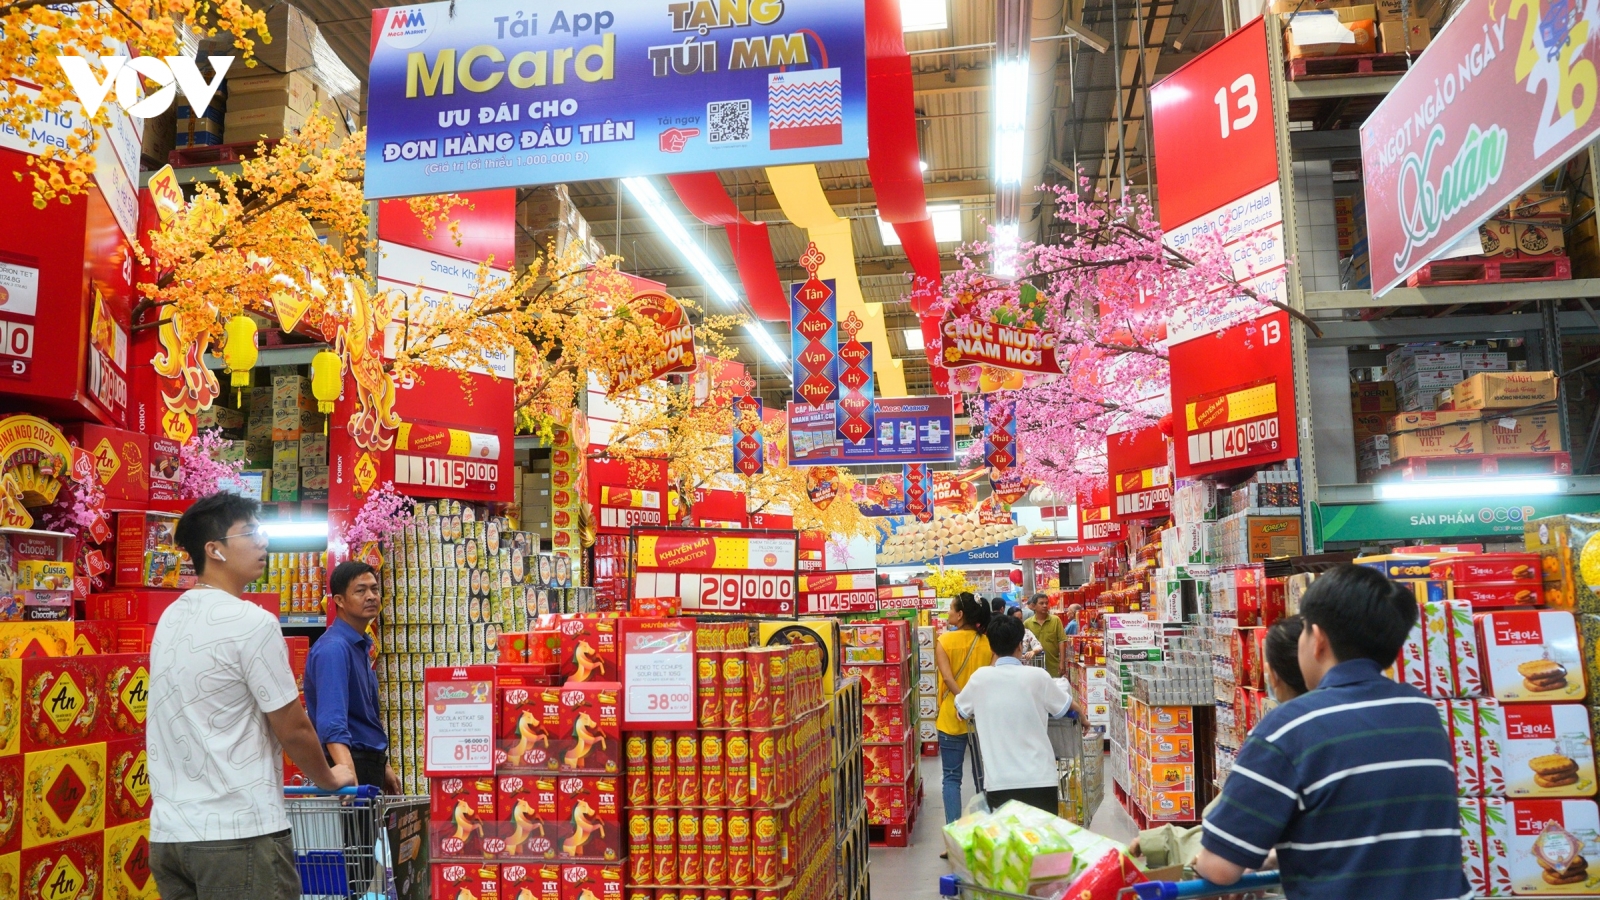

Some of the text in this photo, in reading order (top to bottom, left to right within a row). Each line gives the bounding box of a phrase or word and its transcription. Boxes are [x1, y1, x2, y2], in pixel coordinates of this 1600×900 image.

[494, 10, 614, 39] Tải App
[648, 32, 810, 77] TÚI MM
[405, 32, 615, 98] MCard
[438, 98, 578, 128] ƯU ĐÃI CHO
[1214, 73, 1258, 139] 13
[657, 115, 701, 126] Tải ngay
[383, 120, 635, 162] ĐƠN HÀNG ĐẦU TIÊN
[1378, 117, 1413, 173] NGỌT
[1244, 210, 1273, 230] Products
[430, 260, 459, 277] Snack
[1258, 254, 1276, 266] Bean
[805, 288, 823, 300] Tân
[803, 319, 827, 332] Niên
[1261, 320, 1281, 347] 13
[805, 351, 826, 365] Vạn
[841, 348, 865, 359] Cung
[804, 383, 829, 396] Phúc
[844, 397, 865, 408] Phát
[168, 413, 187, 434] An
[848, 423, 862, 434] Tài
[14, 424, 56, 448] NGỌ 2026
[991, 433, 1009, 442] Phát
[740, 441, 756, 450] Phát
[96, 448, 116, 469] An
[743, 461, 755, 469] Tài
[995, 455, 1007, 463] Tài
[694, 492, 704, 502] 31
[939, 490, 961, 499] DEAL
[754, 515, 763, 524] 32
[1410, 506, 1535, 526] SẢN PHẨM OCOP
[19, 542, 55, 556] ChocoPie
[659, 537, 710, 561] KHUYẾN MÃI
[968, 551, 999, 559] Seafood
[668, 550, 707, 568] PROMOTION
[42, 564, 67, 575] Custas
[1497, 628, 1540, 641] 그레이스
[1408, 643, 1422, 661] AFC
[1461, 640, 1475, 659] AFC
[1435, 666, 1448, 684] AFC
[52, 686, 77, 713] An
[1509, 722, 1552, 735] 그레이스
[1461, 739, 1474, 758] AFC
[1487, 739, 1500, 758] AFC
[1467, 839, 1480, 858] AFC
[1493, 839, 1507, 858] AFC
[50, 869, 77, 899] An
